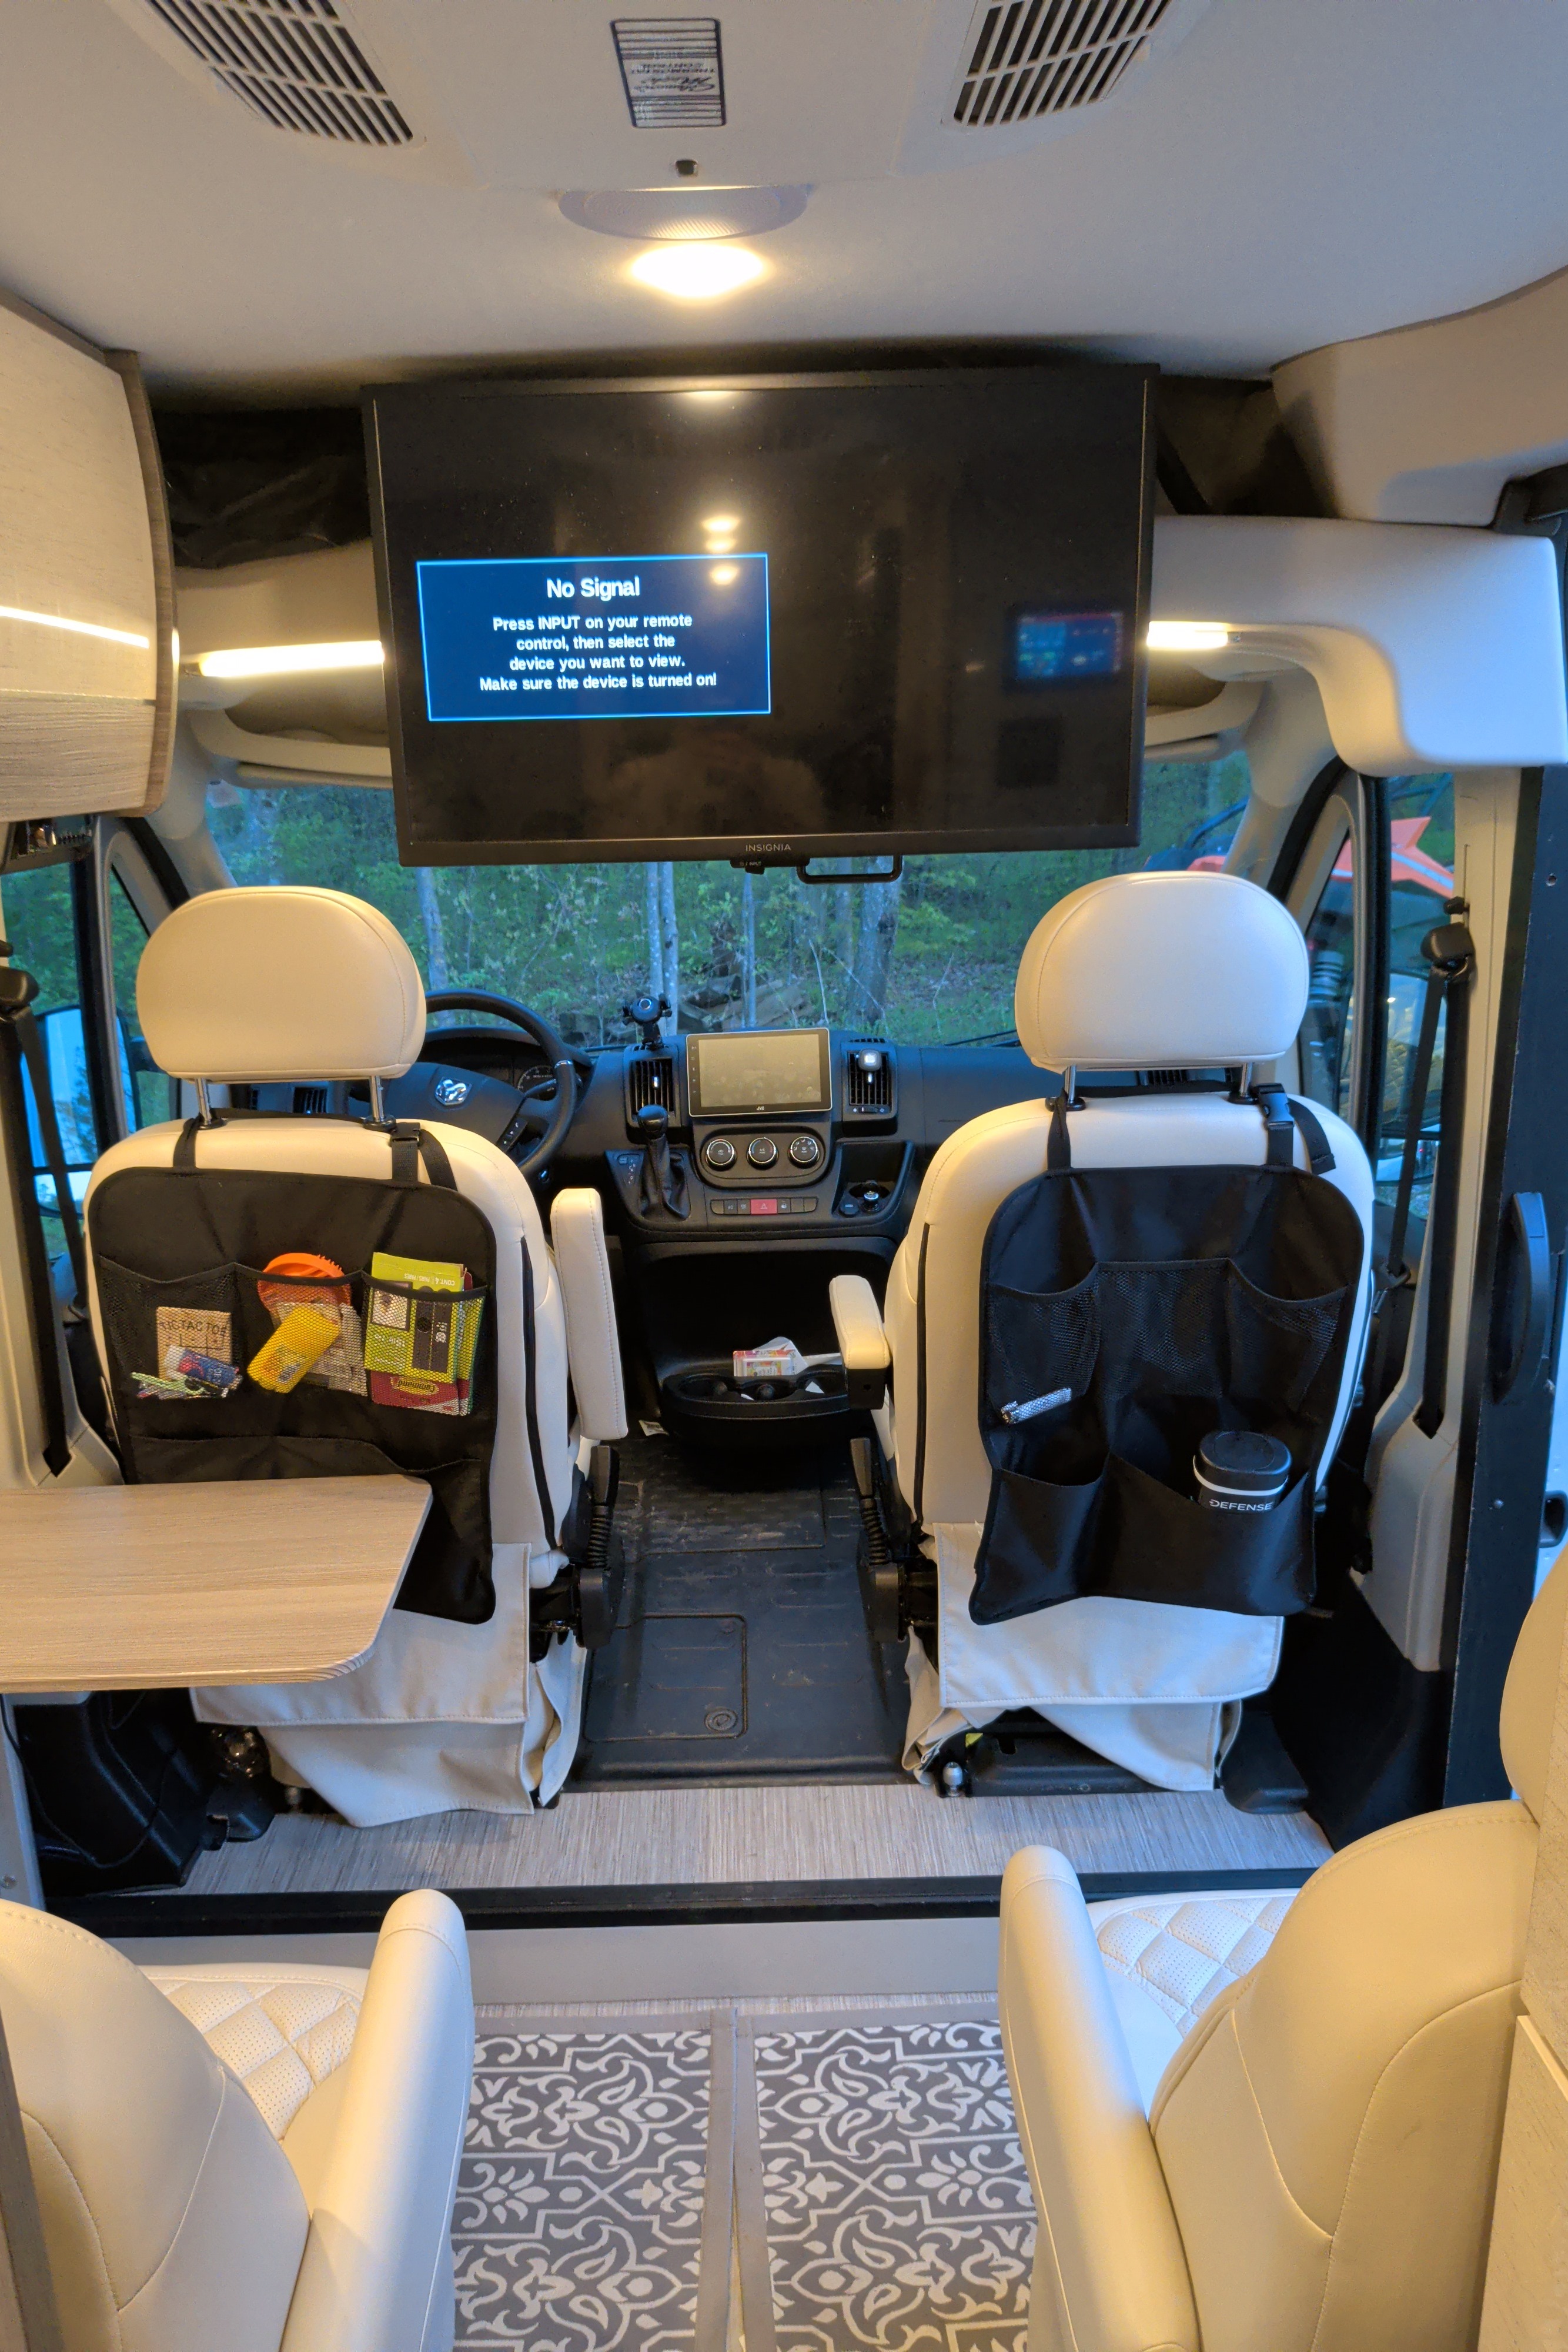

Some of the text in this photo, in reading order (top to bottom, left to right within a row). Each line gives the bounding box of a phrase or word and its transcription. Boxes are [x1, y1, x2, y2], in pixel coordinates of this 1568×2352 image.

[547, 577, 640, 602] No Signal
[493, 614, 693, 632] Press INPUT on your remote
[516, 634, 675, 652] control, then select the
[509, 654, 686, 673] device you want to view.
[480, 673, 717, 691] Make sure the device is turned on!
[745, 843, 791, 852] INSIGNIA
[180, 1320, 203, 1331] TAC
[1209, 1499, 1274, 1511] DEFENSE
